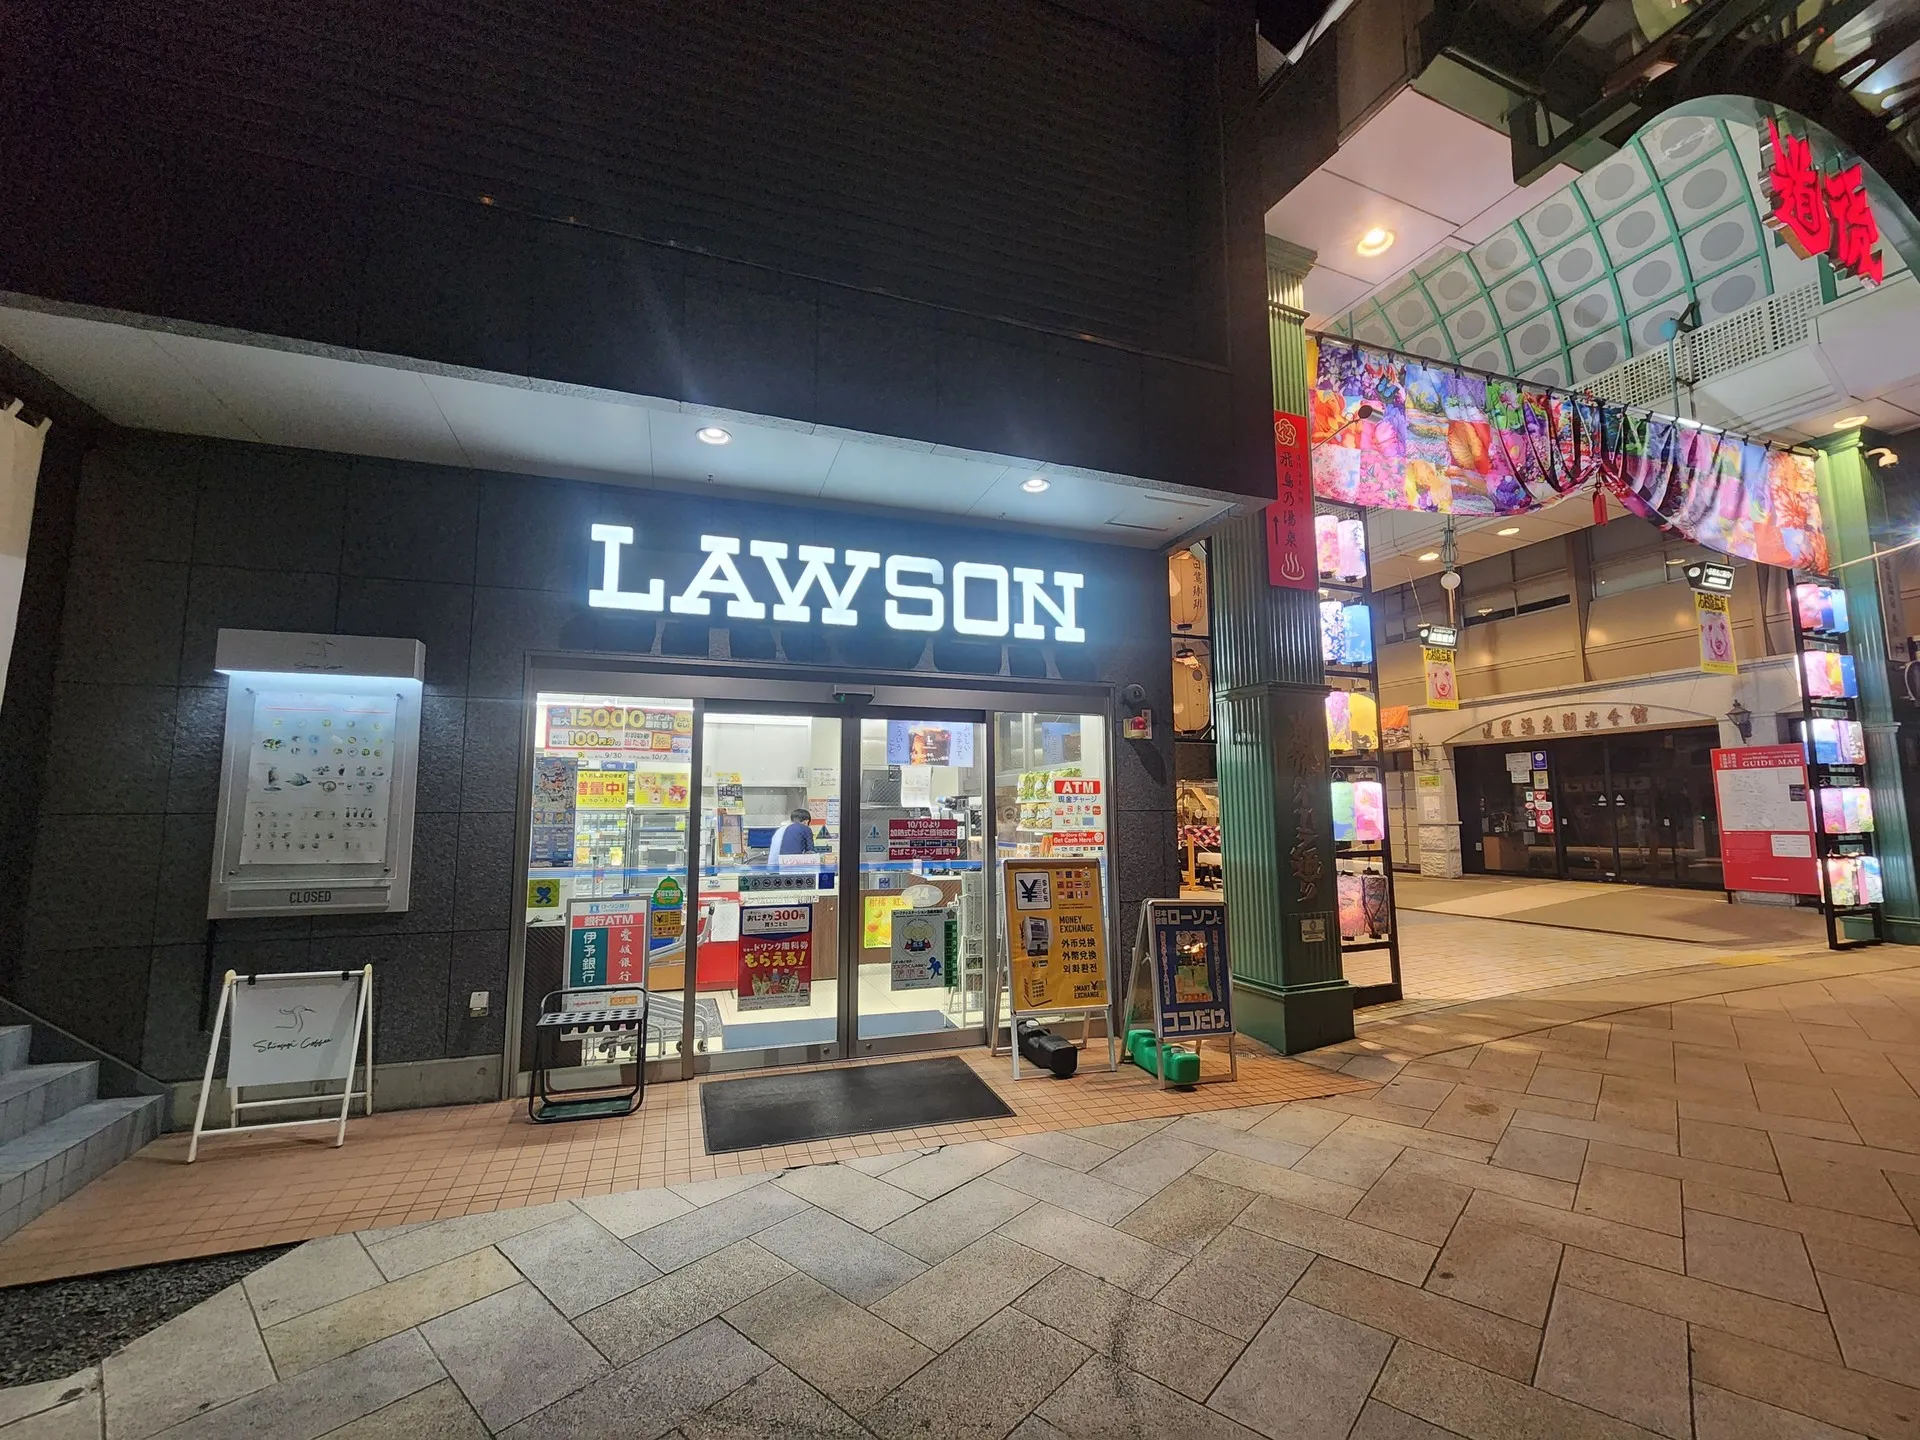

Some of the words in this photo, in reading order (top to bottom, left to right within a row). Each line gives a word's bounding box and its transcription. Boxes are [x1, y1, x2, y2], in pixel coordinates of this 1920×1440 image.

[1279, 451, 1298, 548] 飛鳥乃湯泉
[588, 522, 1085, 643] LAWSON
[1778, 758, 1800, 766] MAP
[1062, 781, 1094, 794] ATM
[289, 890, 332, 904] CLOSED
[583, 914, 634, 927] 銀行ATM
[1059, 915, 1083, 925] MONEY
[1060, 924, 1095, 933] EXCHANGE
[581, 931, 598, 983] 伊予銀行
[618, 930, 633, 982] 愛媛銀行
[744, 951, 806, 968] もらえる!
[1063, 964, 1098, 975] 외화환전
[1074, 990, 1100, 1000] EXCHANGE
[1163, 1008, 1230, 1033] ココだけ。
